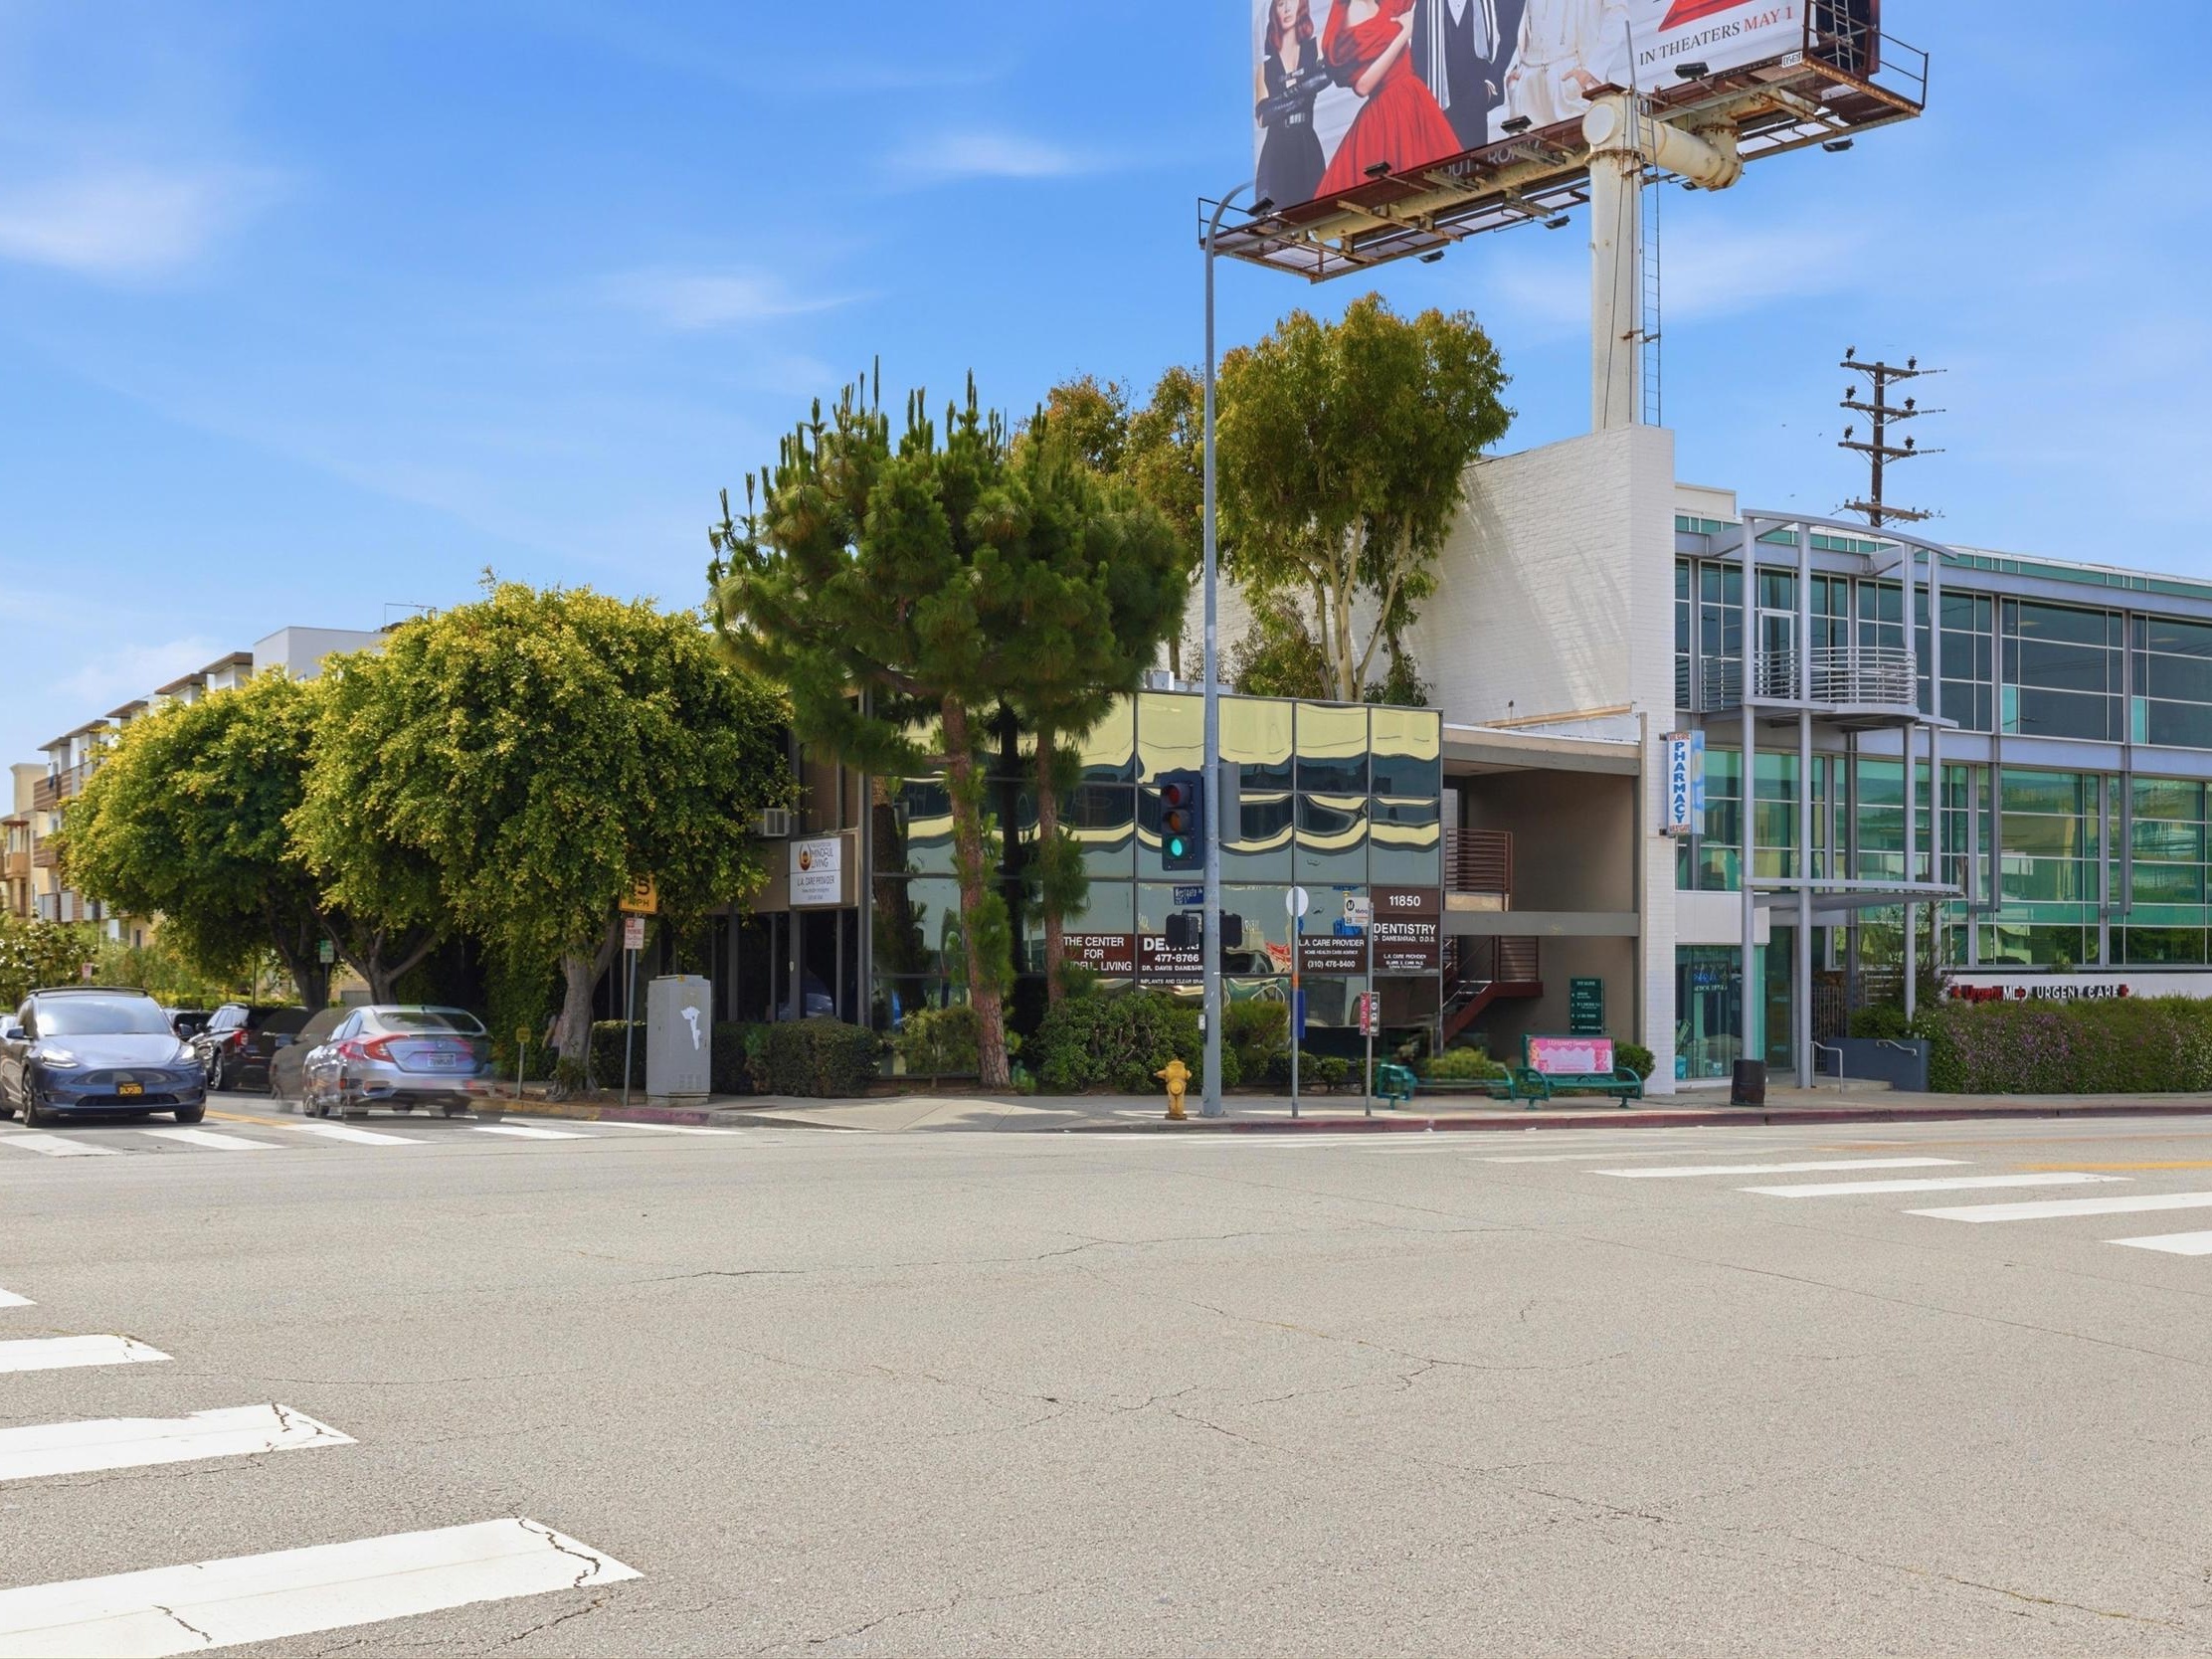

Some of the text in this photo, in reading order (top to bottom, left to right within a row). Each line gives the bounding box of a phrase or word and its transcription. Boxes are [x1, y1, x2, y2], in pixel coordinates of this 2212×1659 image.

[1640, 6, 1793, 66] IN THEATERS MAY 1
[1674, 742, 1686, 824] PHARMACY
[1389, 895, 1421, 906] 11850
[1374, 923, 1436, 935] DENTISTRY
[1063, 936, 1124, 947] THE CENTER
[1084, 949, 1104, 959] FOR
[1155, 954, 1199, 963] 477-8766
[1101, 961, 1133, 971] LIVING
[1307, 960, 1324, 969] (310)
[2037, 986, 2081, 1000] URGENT
[2088, 986, 2120, 999] CARE
